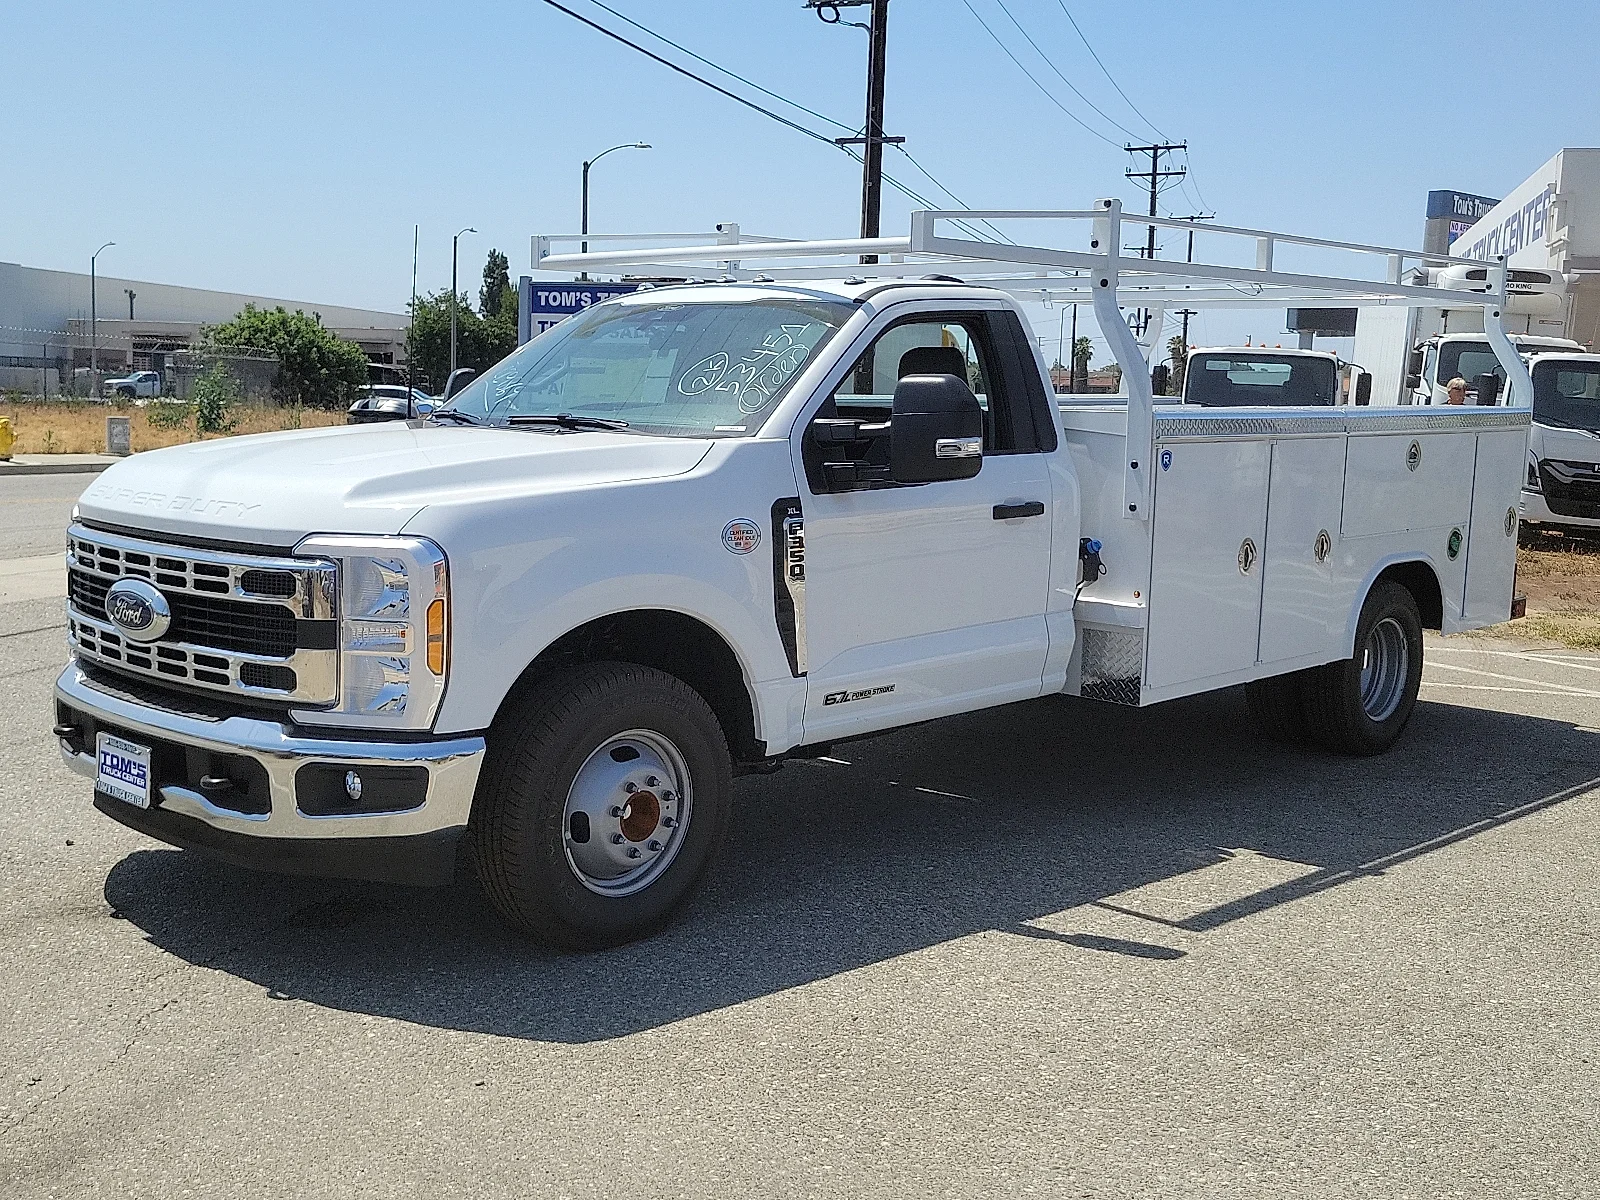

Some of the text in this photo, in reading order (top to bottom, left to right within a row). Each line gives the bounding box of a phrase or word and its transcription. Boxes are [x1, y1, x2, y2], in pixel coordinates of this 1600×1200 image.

[1453, 195, 1494, 218] TOM'S TRUC
[1451, 222, 1459, 231] NO
[1502, 187, 1551, 257] CENTER
[537, 291, 592, 306] TOM'S
[740, 347, 805, 408] Order
[90, 484, 262, 518] SUPER DUTY
[114, 596, 143, 625] Ford
[823, 684, 896, 706] 6.7L POWER STROKE
[100, 750, 147, 778] TOM'S
[102, 764, 122, 778] TRUCK
[122, 771, 146, 787] CENTER
